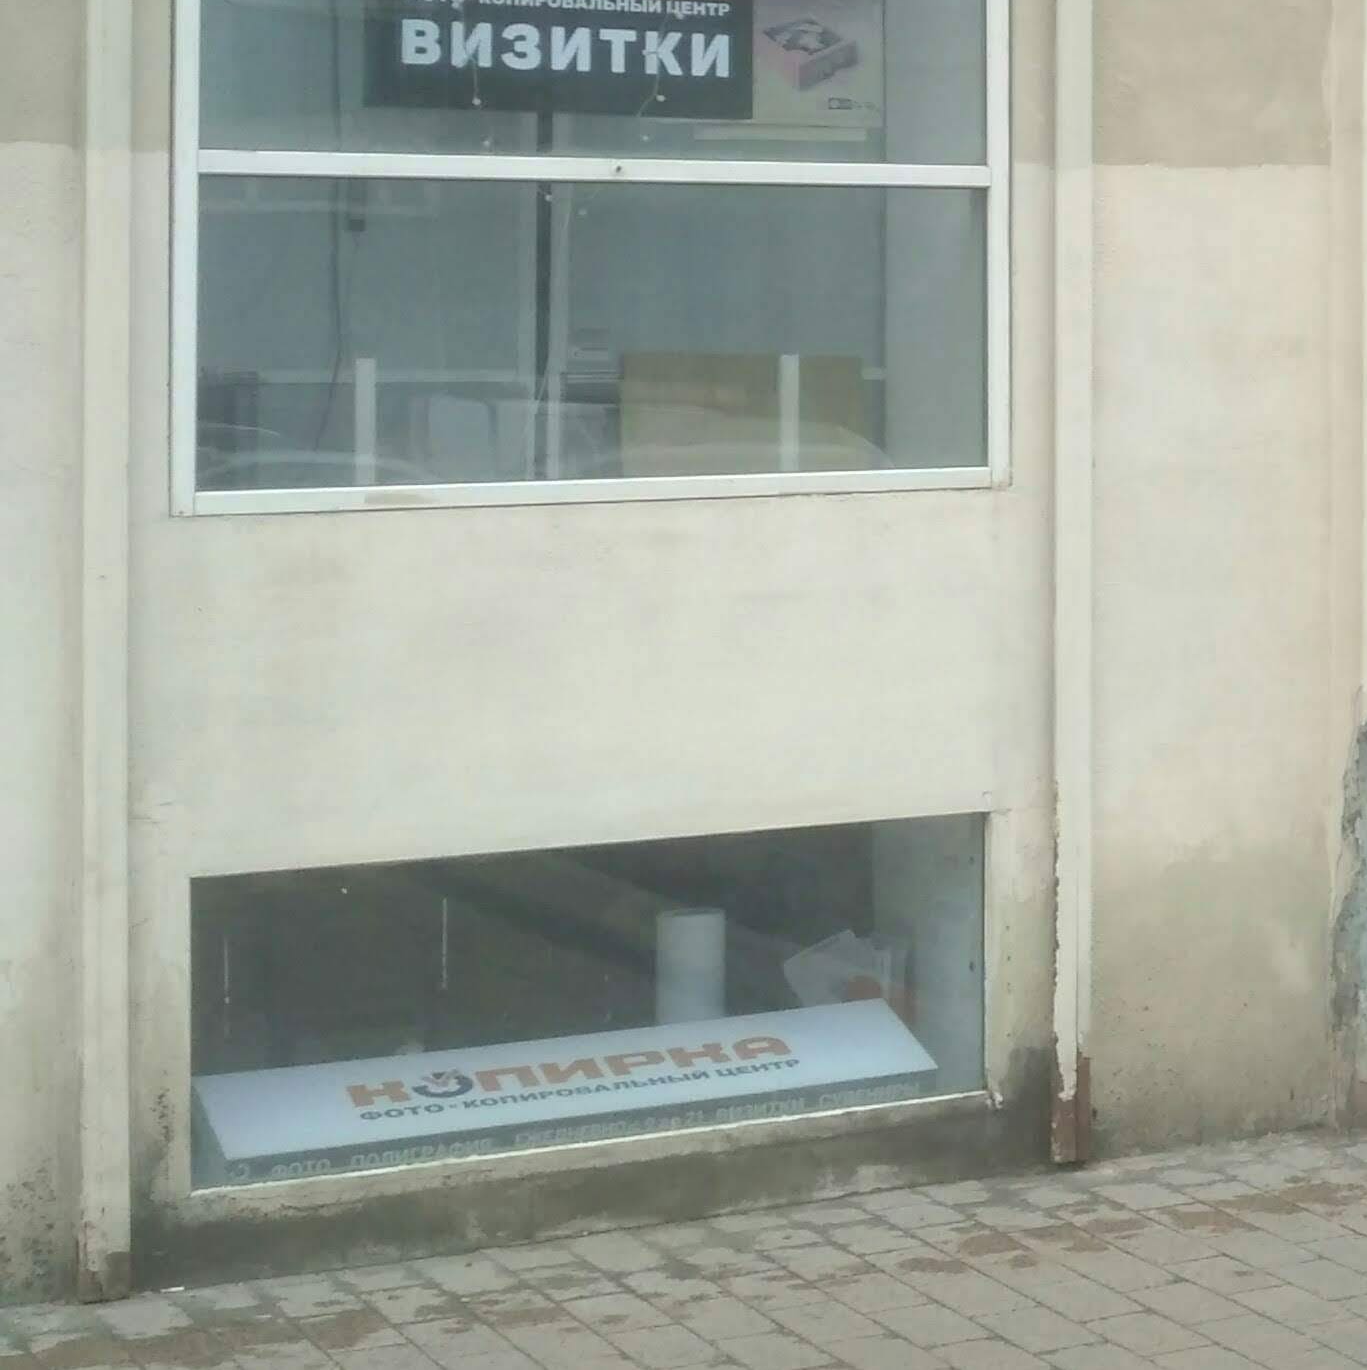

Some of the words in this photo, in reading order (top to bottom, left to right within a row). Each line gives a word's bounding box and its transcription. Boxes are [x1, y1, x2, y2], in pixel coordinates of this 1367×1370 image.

[666, 0, 731, 18] ЦЕНТР
[402, 19, 730, 78] ВИЗИТКИ
[715, 1058, 800, 1079] ЦЕНТР
